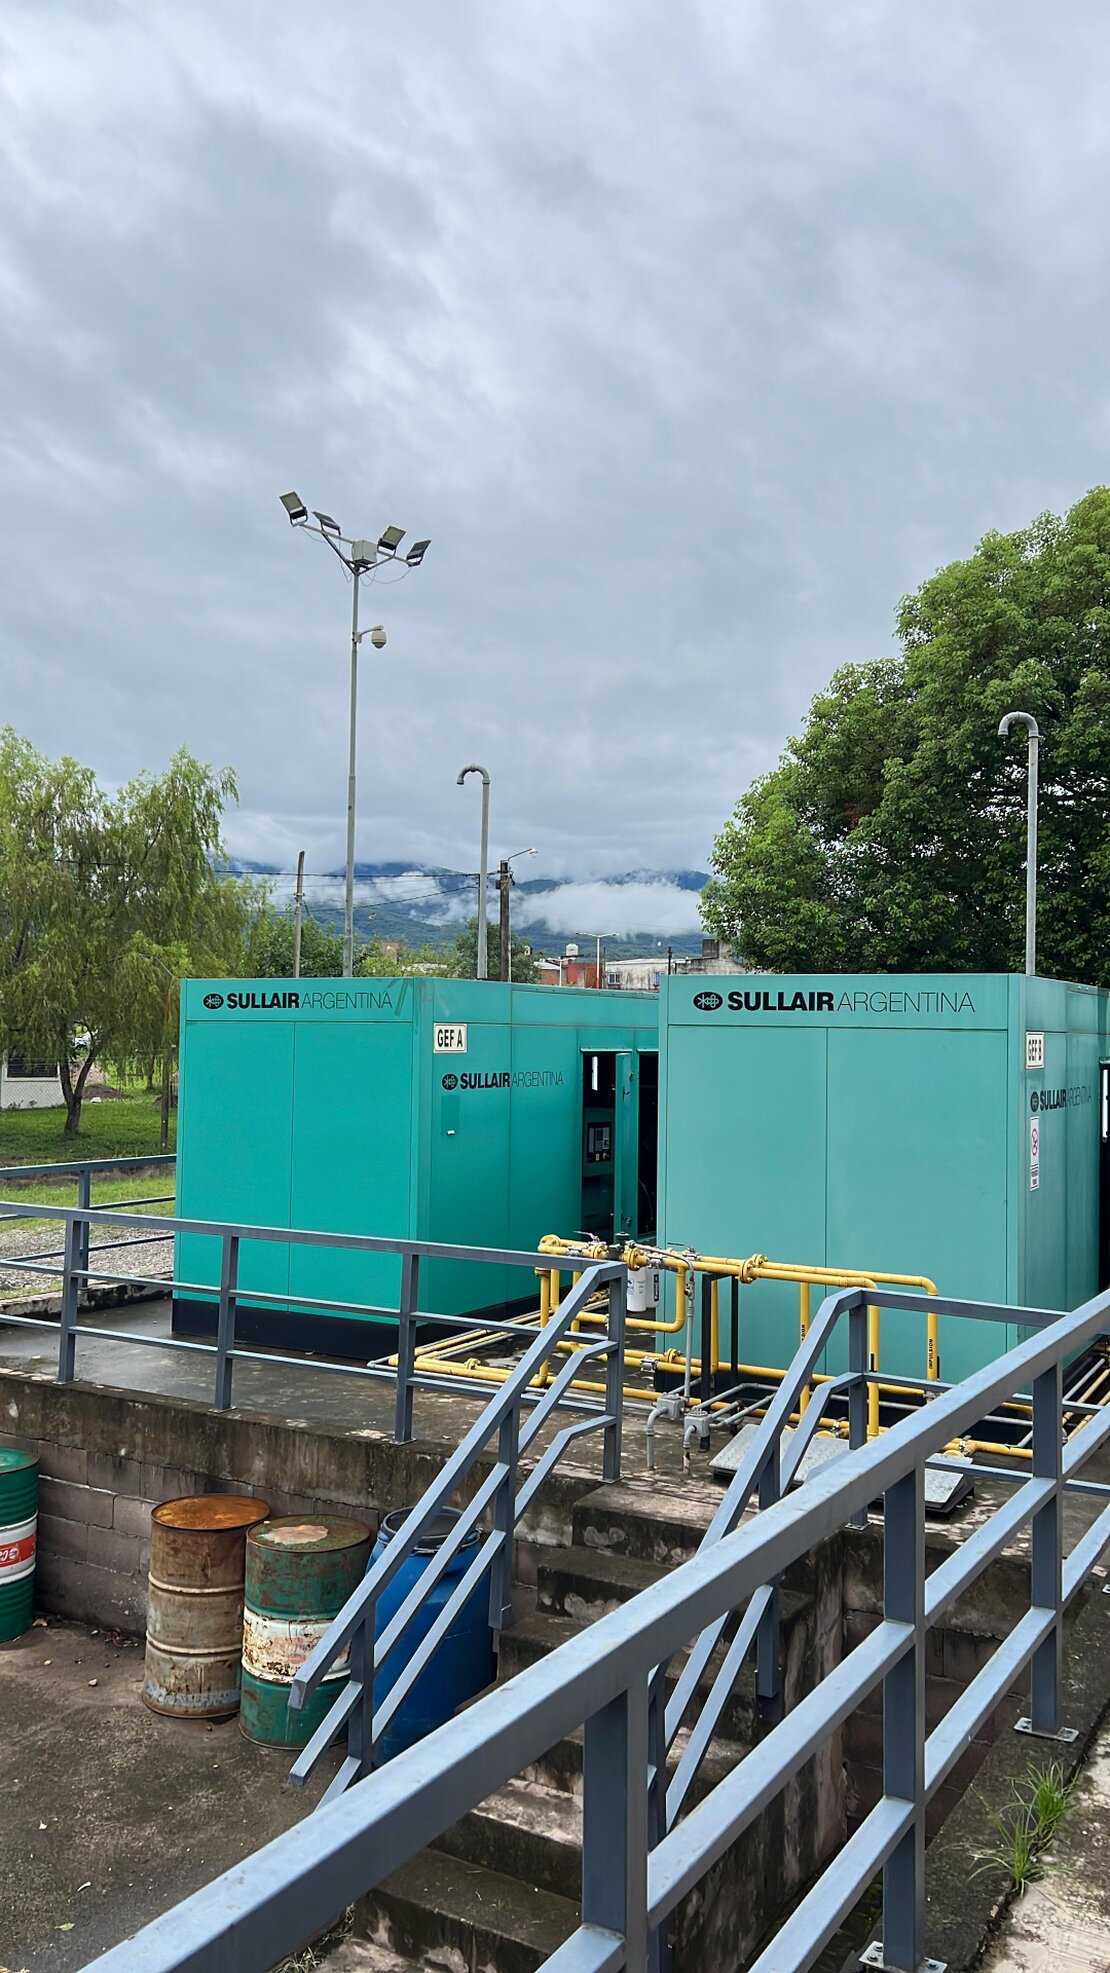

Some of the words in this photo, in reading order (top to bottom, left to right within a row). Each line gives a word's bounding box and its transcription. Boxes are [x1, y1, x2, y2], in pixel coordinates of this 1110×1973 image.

[226, 992, 300, 1009] SULLAIR
[301, 992, 393, 1010] ARGENTINA
[727, 991, 835, 1012] SULLAIR
[837, 991, 976, 1013] ARGENTINA
[437, 1028, 455, 1048] GEF
[456, 1028, 464, 1048] A
[459, 1072, 511, 1090] SULLAIR
[511, 1070, 563, 1088] ARGENTINA
[1039, 1088, 1067, 1111] SULLAIR
